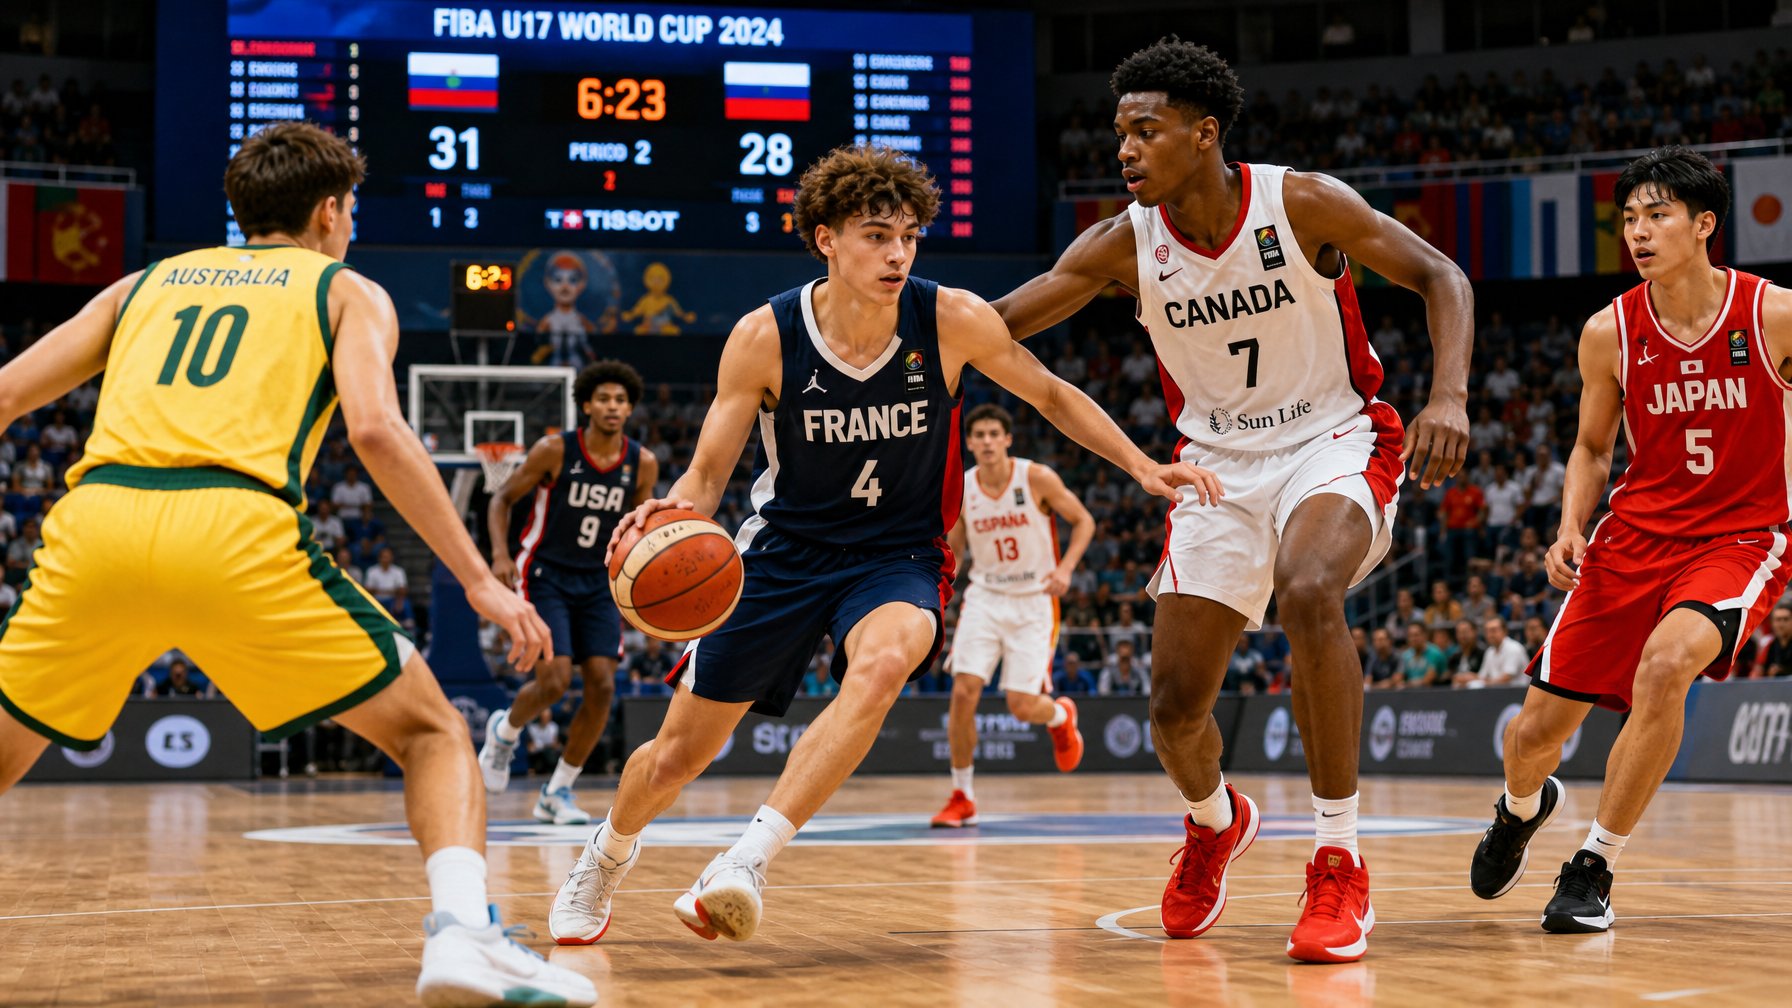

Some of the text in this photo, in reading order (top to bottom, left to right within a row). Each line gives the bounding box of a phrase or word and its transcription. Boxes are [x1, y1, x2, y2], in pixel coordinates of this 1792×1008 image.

[434, 8, 784, 47] FIBA U17 WORLD CUP 2024
[577, 78, 666, 120] 6:23
[429, 126, 479, 170] 31
[634, 140, 652, 165] 2
[740, 132, 793, 176] 28
[429, 207, 442, 228] 1
[584, 210, 680, 231] TISSOT
[161, 268, 290, 287] AUSTRALIA
[1164, 279, 1296, 329] CANADA
[156, 304, 249, 387] 10
[1228, 338, 1259, 389] 7
[1237, 399, 1312, 431] Sun Life
[1646, 377, 1747, 415] JAPAN
[803, 400, 929, 443] FRANCE
[1685, 429, 1714, 475] 5
[568, 481, 625, 512] USA
[850, 459, 882, 507] 4
[577, 515, 600, 548] 9
[994, 536, 1019, 562] 13
